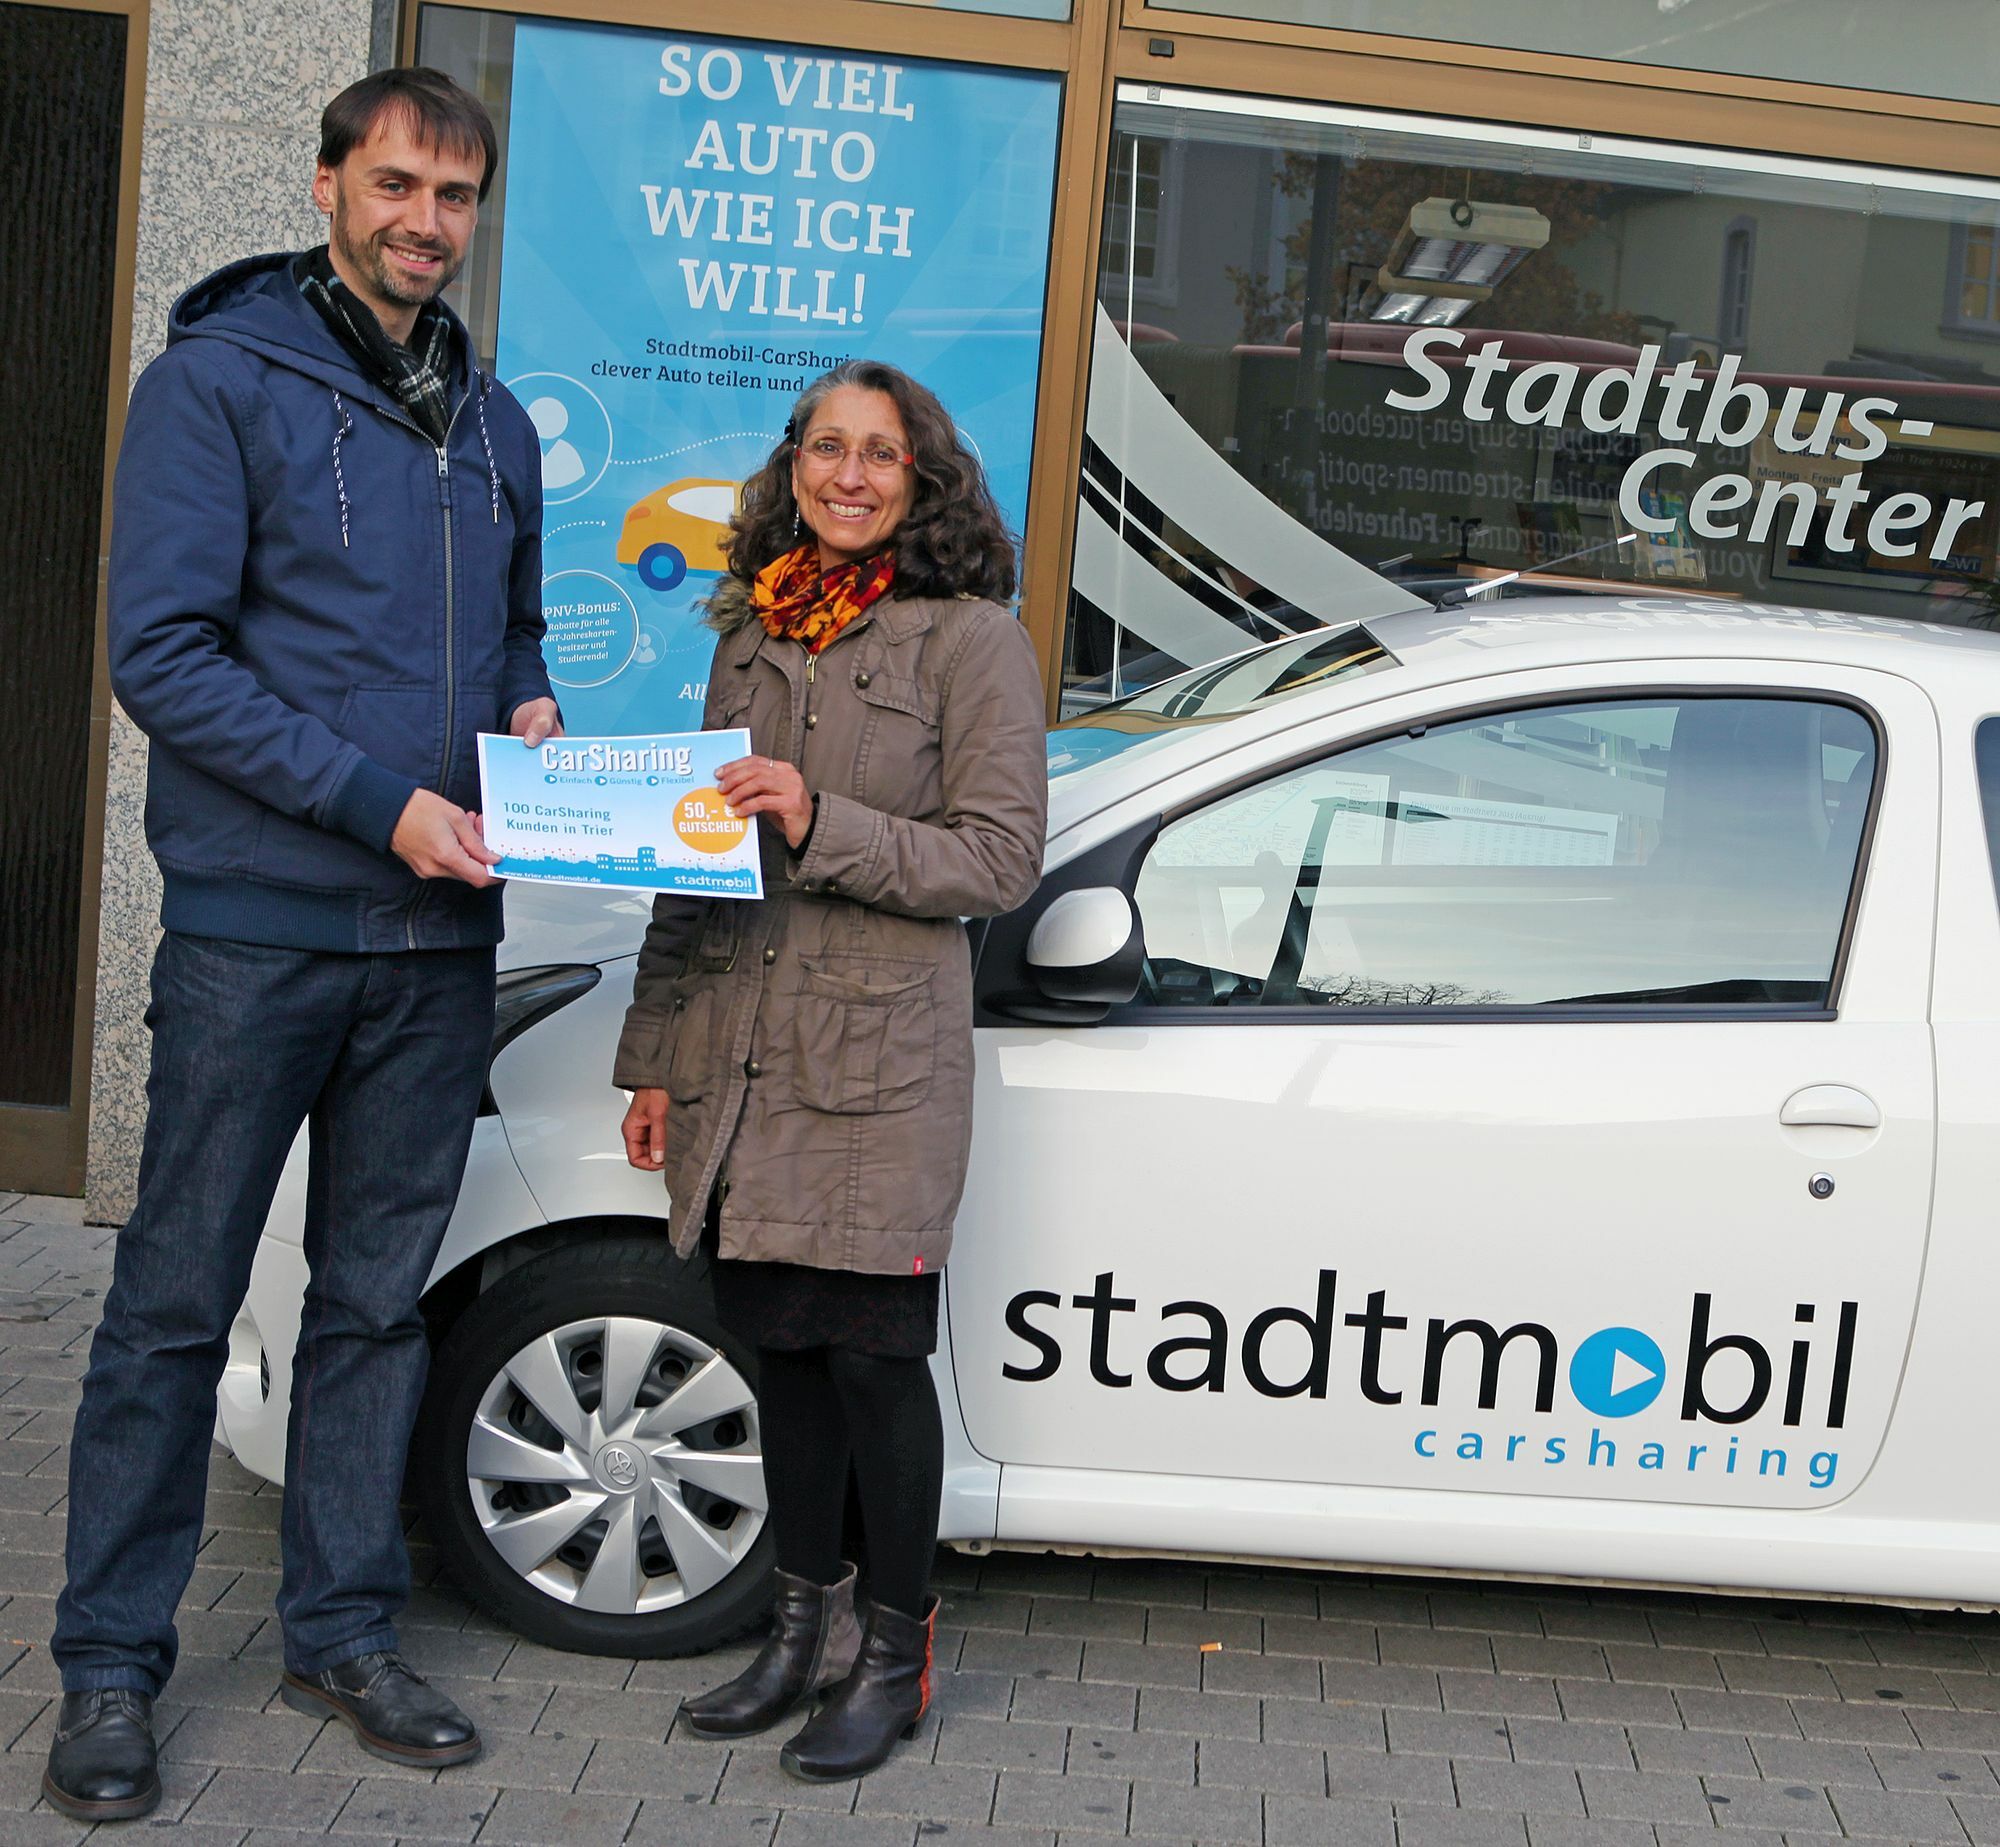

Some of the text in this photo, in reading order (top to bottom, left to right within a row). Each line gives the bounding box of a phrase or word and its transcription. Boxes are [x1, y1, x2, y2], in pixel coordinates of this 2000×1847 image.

[659, 45, 914, 121] SO VIEL
[684, 119, 875, 183] AUTO
[640, 185, 914, 258] WIE ICH
[679, 258, 866, 325] WILL!
[646, 338, 857, 369] Stadtmobil-CarShari
[591, 360, 804, 392] clever Auto teilen und
[1385, 327, 1934, 462] Stadtbus-
[1757, 467, 1799, 481] Montag
[1812, 473, 1844, 484] Freita
[1618, 448, 1986, 560] Center
[542, 602, 621, 619] PNV-Bonus:
[548, 617, 610, 632] Rabatte für alle
[557, 640, 606, 652] besitzer und
[541, 742, 693, 776] CarSharing
[560, 775, 694, 786] Einfach Günstig Flexibel
[503, 801, 612, 822] 100 CarSharing
[678, 820, 744, 833] GUTSCHEIN
[506, 819, 615, 836] Kunden in Trier
[674, 875, 752, 888] stadtmobil
[1002, 1269, 1859, 1429] stadtmobil
[1414, 1428, 1840, 1487] carsharing
